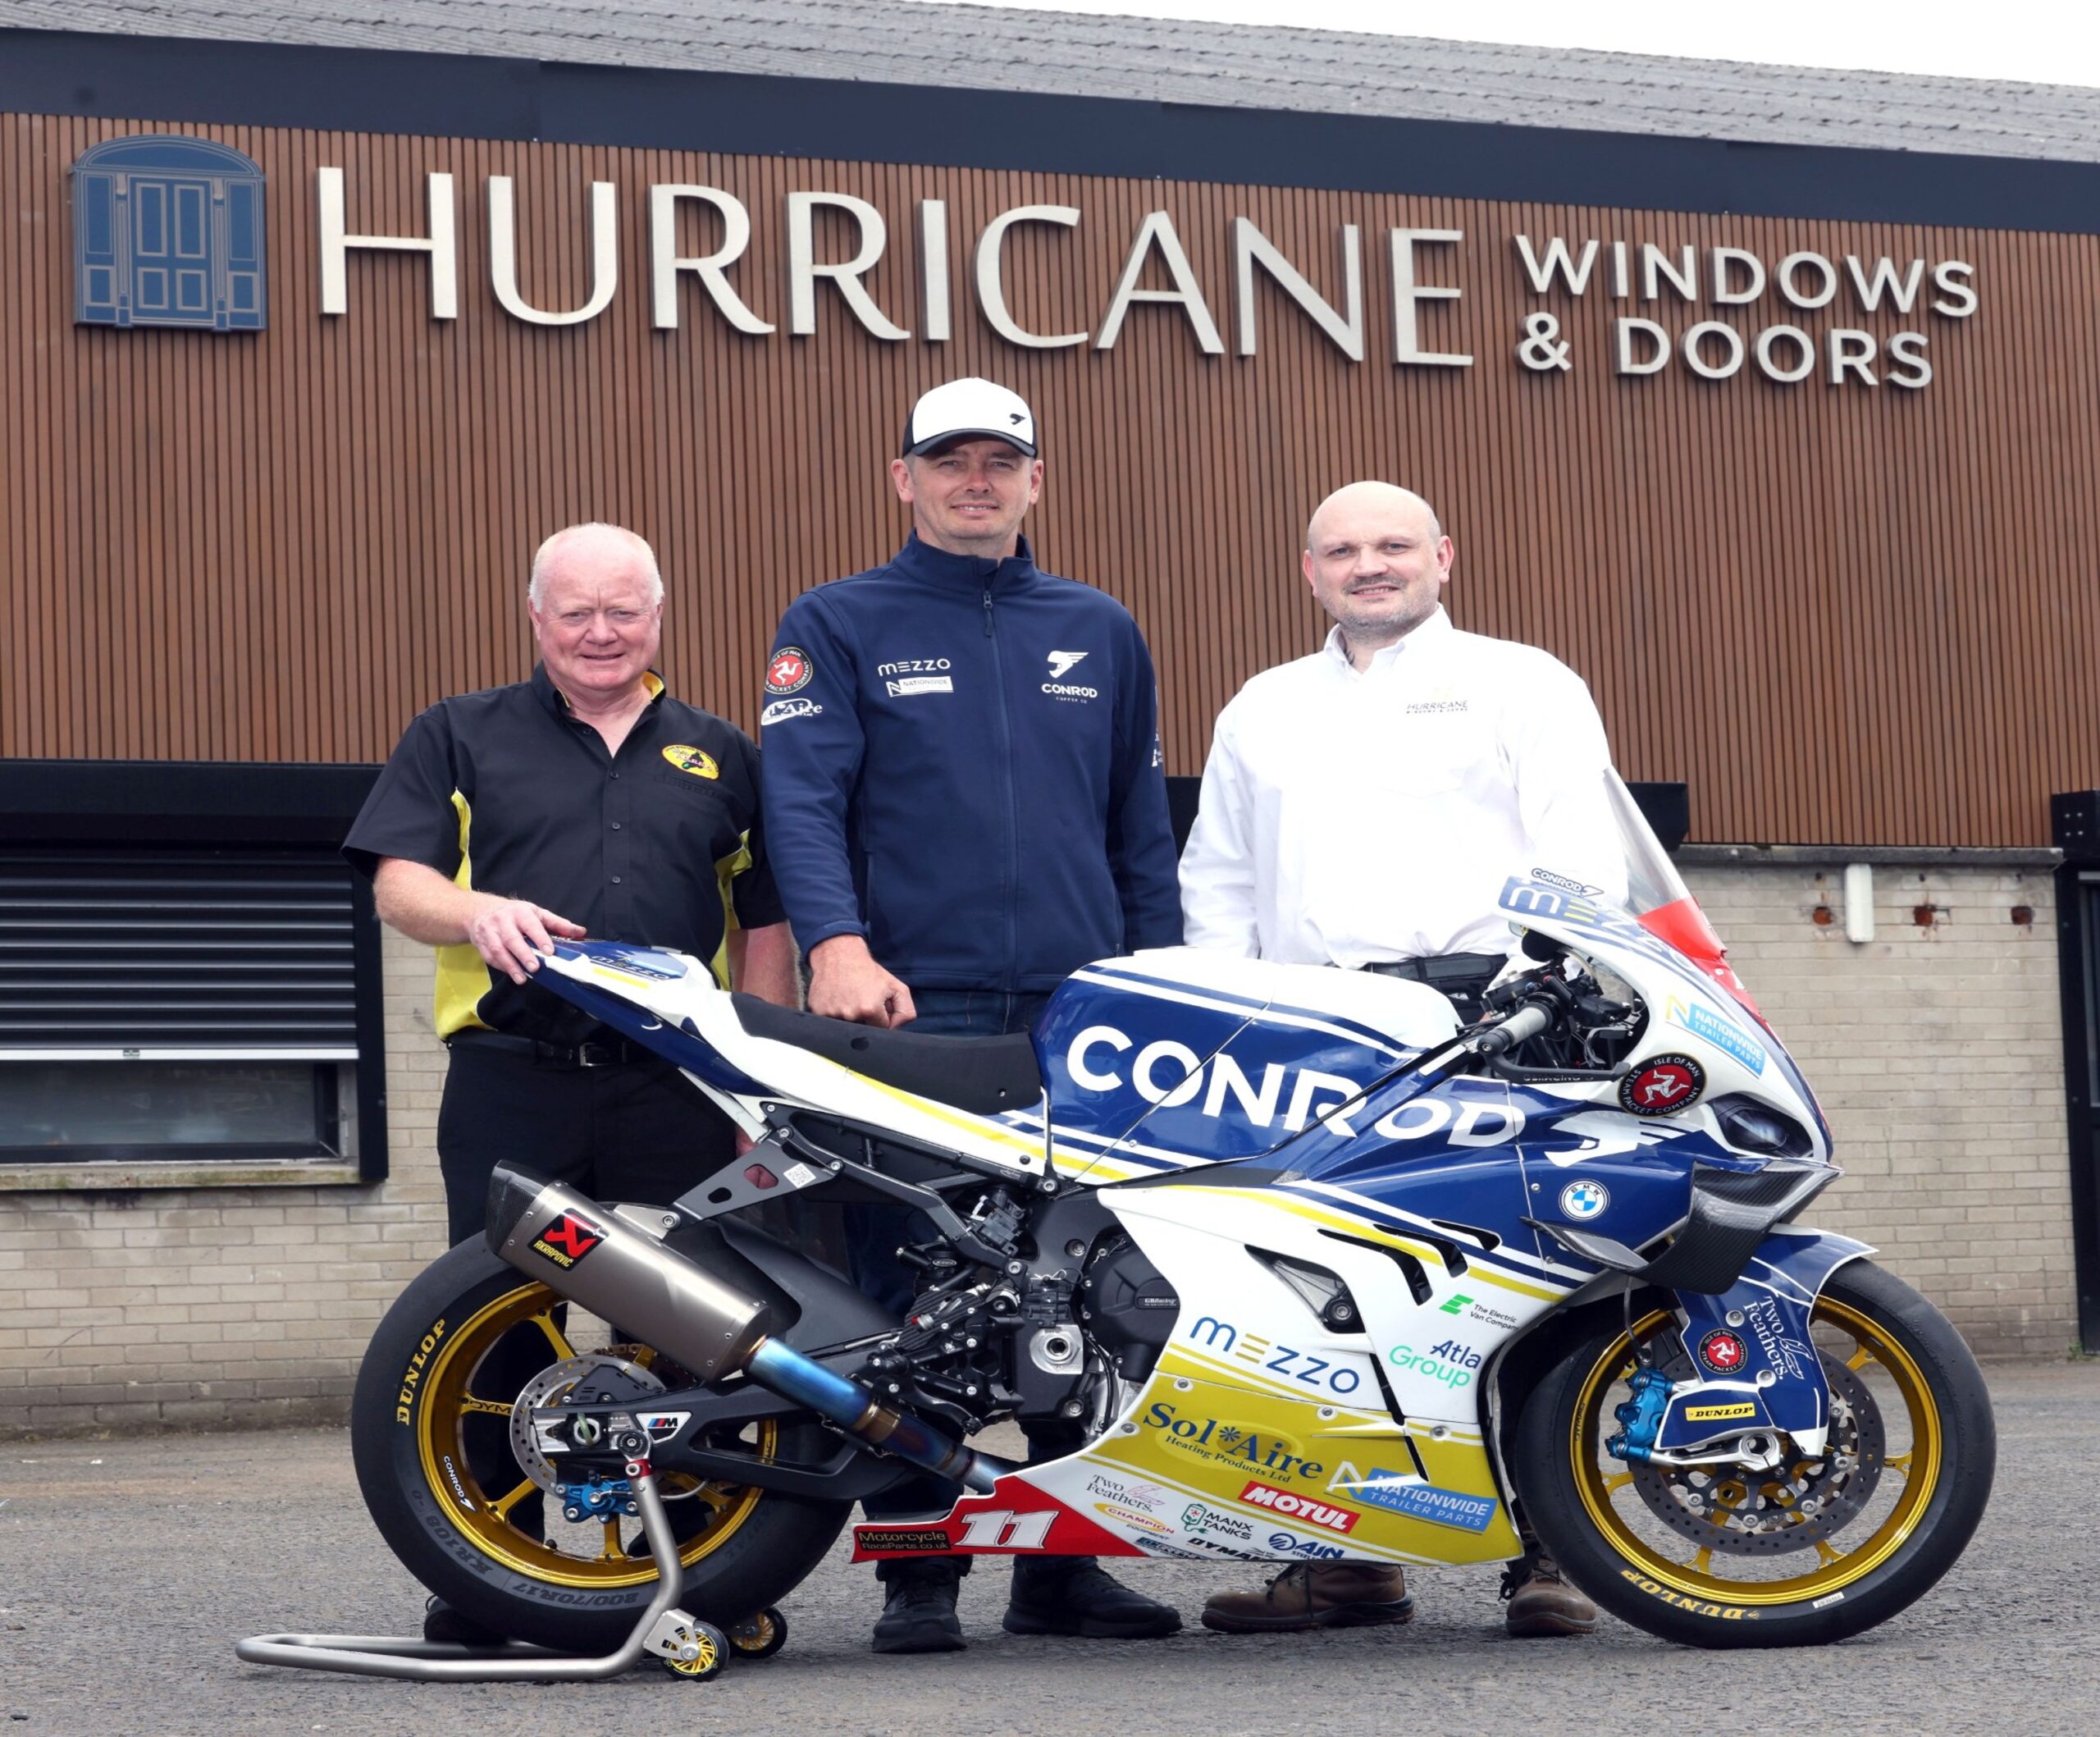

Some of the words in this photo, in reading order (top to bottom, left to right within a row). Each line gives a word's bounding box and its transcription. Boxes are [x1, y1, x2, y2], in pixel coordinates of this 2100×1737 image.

[317, 167, 1474, 366] HURRICANE
[1514, 235, 1978, 318] WINDOWS
[1516, 312, 1572, 371] &
[1615, 317, 1933, 388] DOORS
[1041, 683, 1098, 698] CONROD
[1407, 700, 1468, 710] HURRICANE
[1532, 868, 1582, 892] CONROD
[1694, 1021, 1732, 1049] TRAILER
[1735, 1046, 1760, 1069] PARTS
[1695, 1008, 1763, 1061] NATIONWIDE
[1654, 1057, 1671, 1065] ISLE
[1686, 1062, 1701, 1076] MAN
[1066, 1025, 1526, 1147] CONROD
[1623, 1069, 1641, 1095] STEAM
[1623, 1095, 1653, 1114] PACKET
[1655, 1086, 1701, 1113] COMPANY
[1570, 1184, 1601, 1195] BMW
[1470, 1312, 1485, 1320] Van
[1475, 1304, 1488, 1313] The
[1489, 1310, 1518, 1323] Electric
[1760, 1296, 1785, 1333] Two
[397, 1319, 445, 1426] DUNLOP
[1389, 1345, 1471, 1389] Group
[1695, 1406, 1753, 1417] DUNLOP
[1165, 1435, 1212, 1459] Heating
[1214, 1452, 1267, 1476] Products
[1269, 1471, 1292, 1483] Ltd
[443, 1455, 465, 1498] CONROD
[1244, 1486, 1349, 1530] MOTUL
[1370, 1492, 1431, 1515] TRAILER
[1437, 1510, 1482, 1526] PARTS
[1374, 1475, 1490, 1516] NATIONWIDE
[955, 1510, 1061, 1549] 11
[1108, 1508, 1175, 1534] CHAMPION
[1125, 1524, 1171, 1540] EQUIPMENT
[1203, 1520, 1252, 1540] TANKS
[1206, 1512, 1253, 1532] MANX
[425, 1515, 493, 1575] KR108
[858, 1531, 946, 1543] Motorcycle
[862, 1542, 948, 1550] RaceParts.co.uk
[513, 1583, 639, 1606] 200/70R17
[1620, 1569, 1747, 1620] DUNLOP
